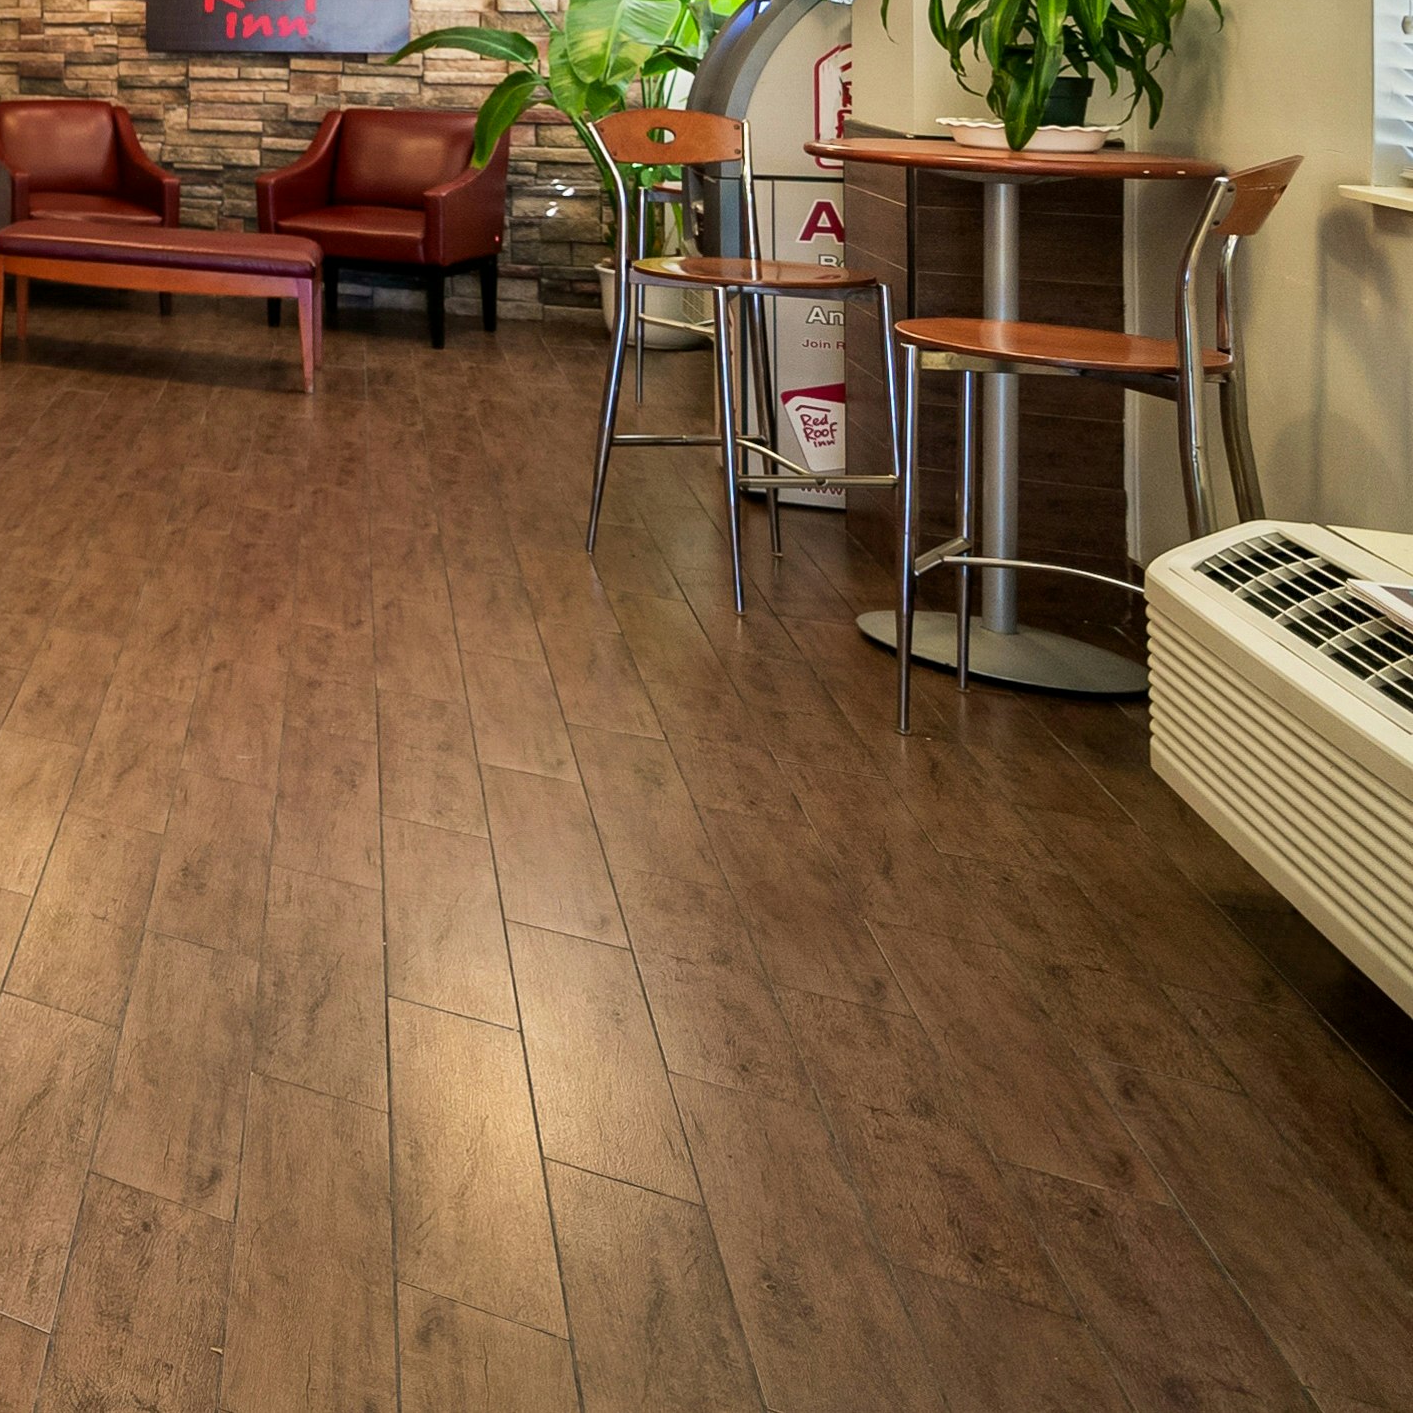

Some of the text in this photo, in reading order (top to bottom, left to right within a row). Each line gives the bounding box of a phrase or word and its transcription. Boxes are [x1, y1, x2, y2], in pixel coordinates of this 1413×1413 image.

[226, 12, 309, 39] inn
[801, 339, 831, 349] Join
[800, 414, 829, 427] Red
[803, 422, 838, 442] Roof
[813, 440, 836, 448] inn
